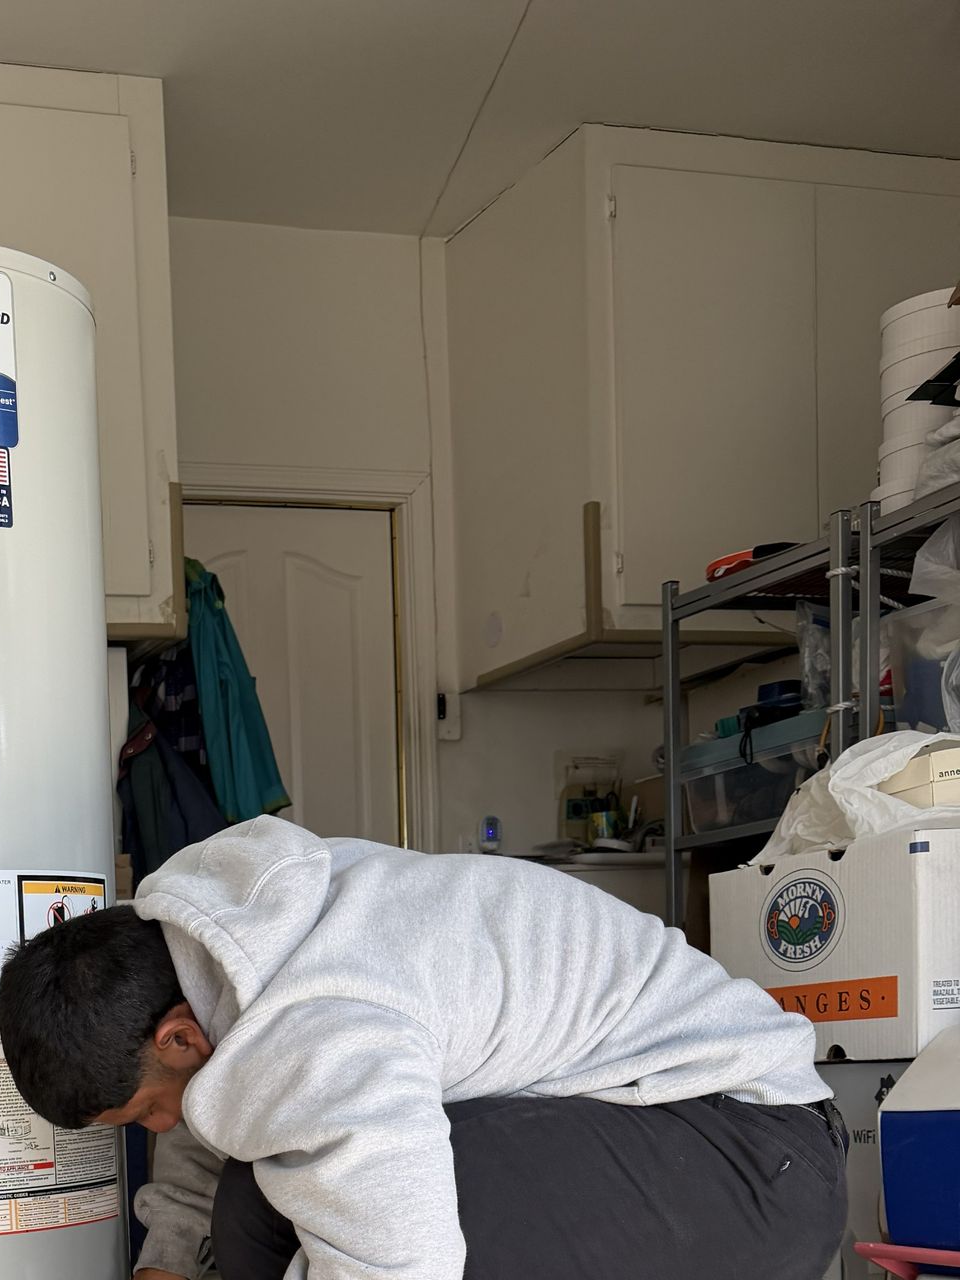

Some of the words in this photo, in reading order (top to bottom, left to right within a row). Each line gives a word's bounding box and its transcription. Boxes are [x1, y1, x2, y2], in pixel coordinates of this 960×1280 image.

[62, 886, 86, 894] WARNING
[779, 934, 820, 959] FRESH
[852, 1129, 876, 1144] WiFi
